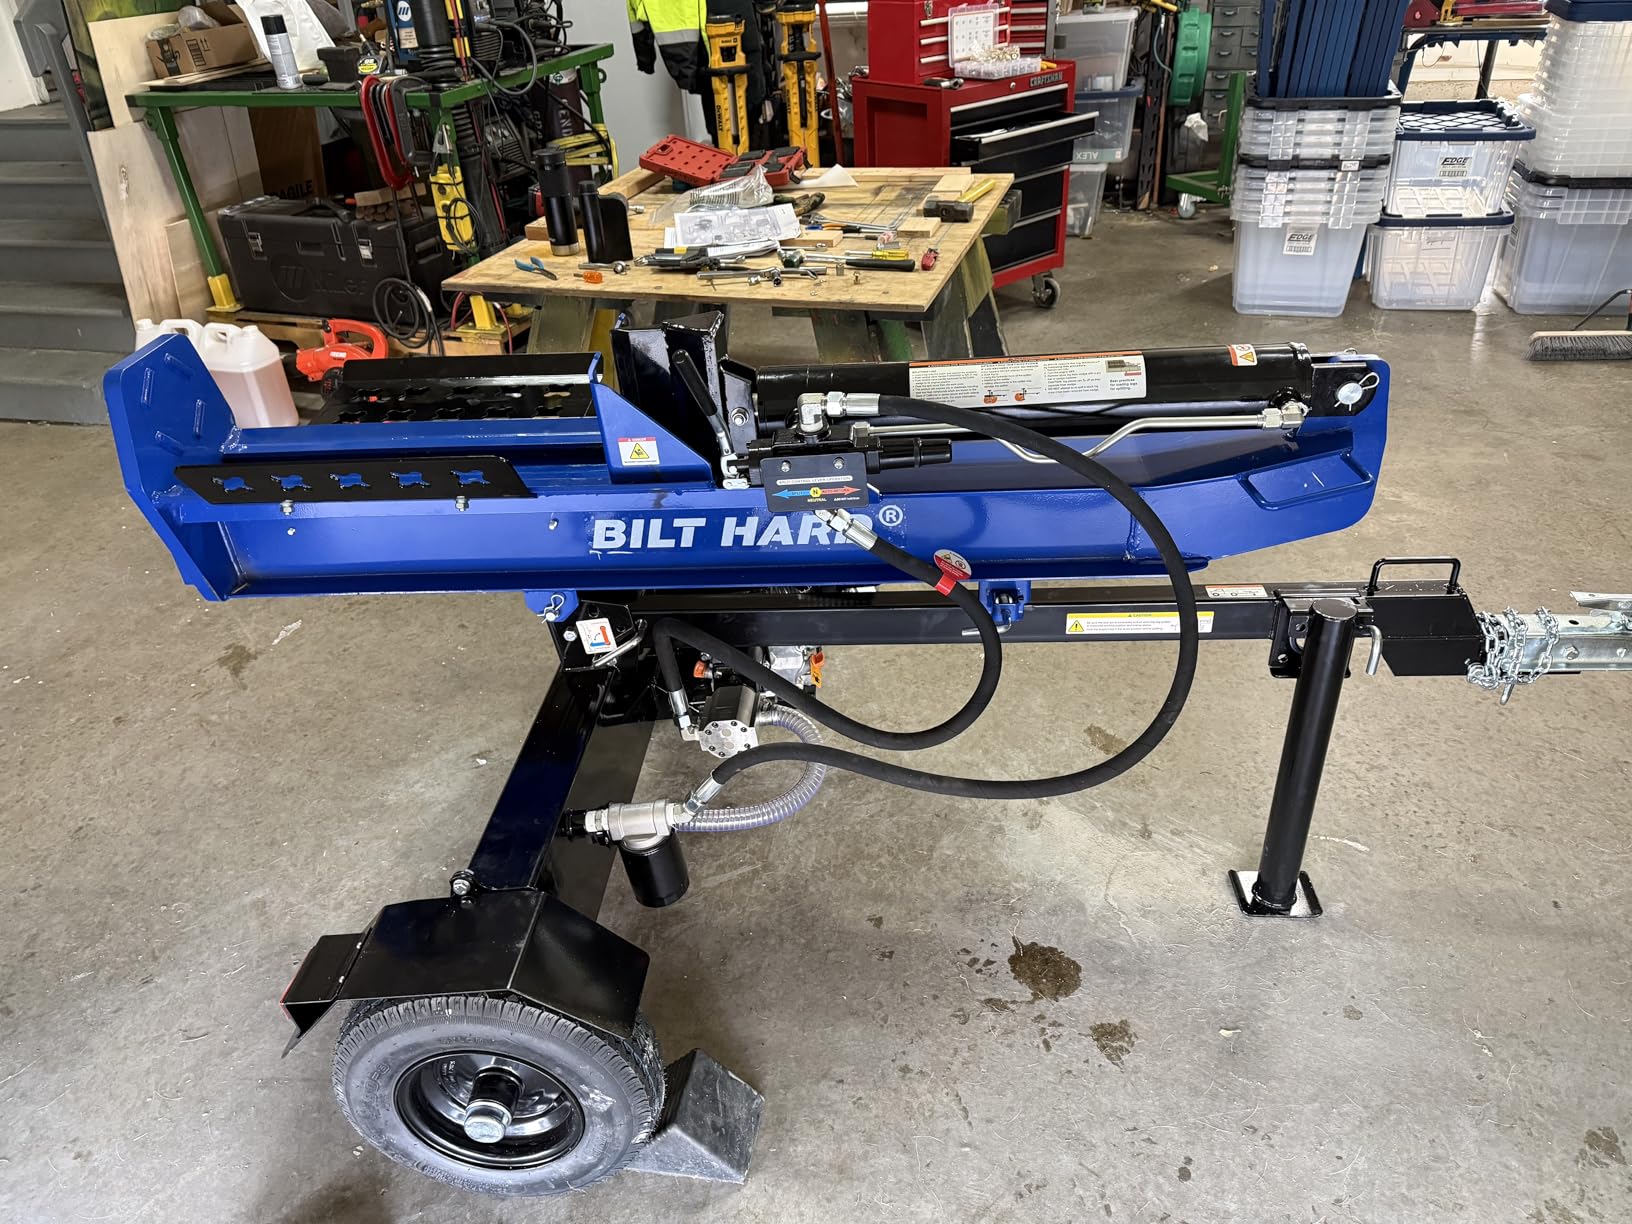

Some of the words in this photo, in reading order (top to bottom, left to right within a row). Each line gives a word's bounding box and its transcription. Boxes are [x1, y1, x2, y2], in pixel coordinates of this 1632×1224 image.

[1030, 72, 1063, 87] CRAFTSMAN
[1076, 151, 1099, 160] ALEX
[1441, 157, 1470, 166] EDGE
[1287, 233, 1315, 242] EDGE
[592, 517, 706, 549] BILT
